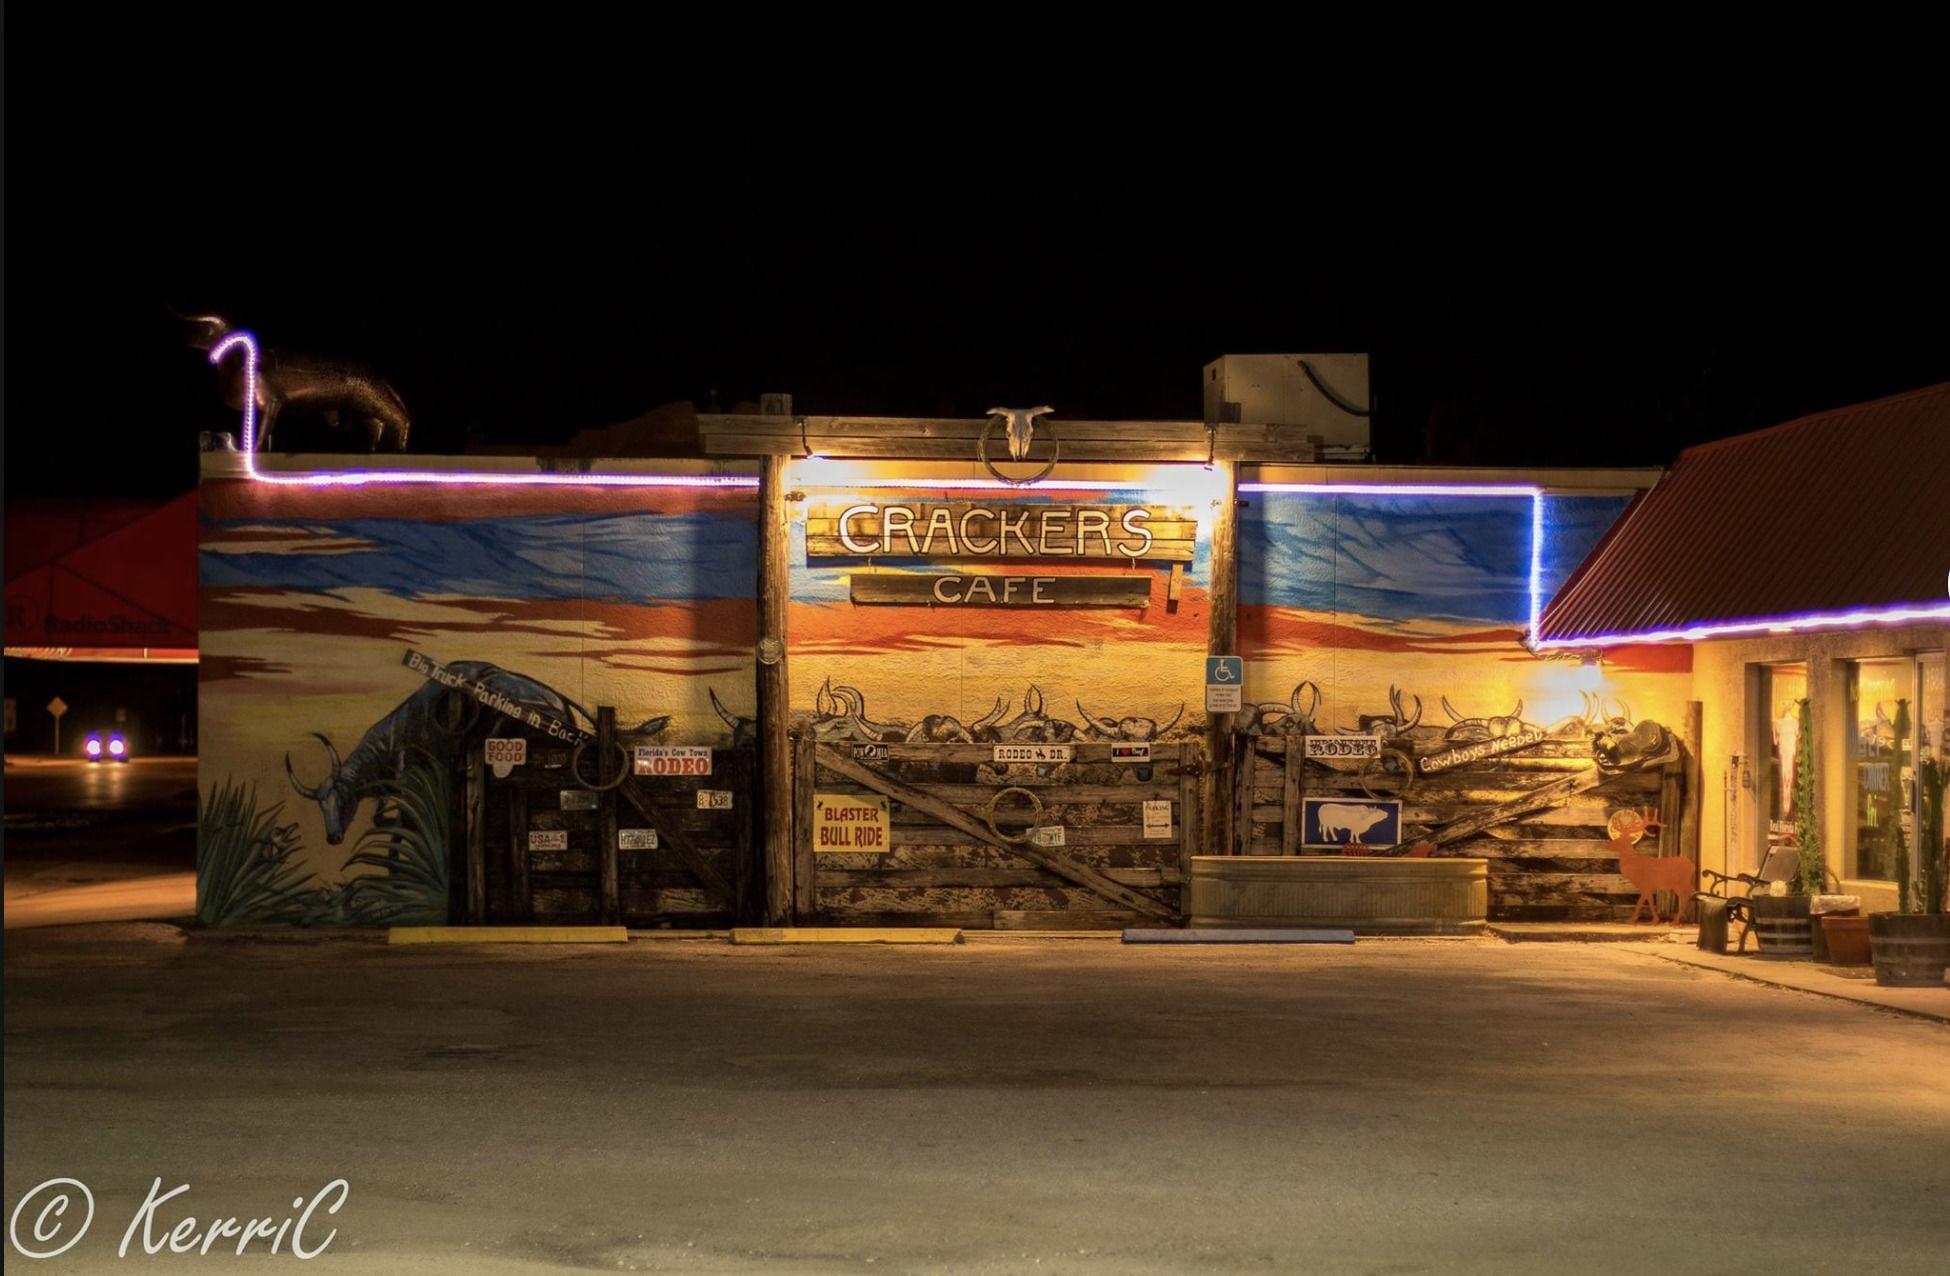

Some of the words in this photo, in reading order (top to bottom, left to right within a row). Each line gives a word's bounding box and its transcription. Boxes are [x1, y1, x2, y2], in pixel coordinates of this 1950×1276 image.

[839, 504, 1154, 557] CRACKERS
[933, 576, 1057, 605] CAFE
[45, 615, 170, 633] RadioShack
[407, 653, 428, 675] Big
[431, 662, 468, 688] Truck
[473, 683, 523, 719] Parking
[547, 719, 590, 747] Back
[487, 741, 524, 752] GOOD
[638, 748, 669, 757] Florida's
[672, 748, 687, 756] Cow
[690, 749, 709, 757] Town
[998, 749, 1033, 760] RODEO
[1049, 749, 1068, 760] DR.
[488, 753, 523, 763] FOOD
[638, 758, 709, 774] RODEO
[1419, 743, 1486, 772] Cowboys
[825, 807, 879, 823] BLASTER
[820, 827, 851, 846] BULL
[854, 827, 883, 848] RIDE
